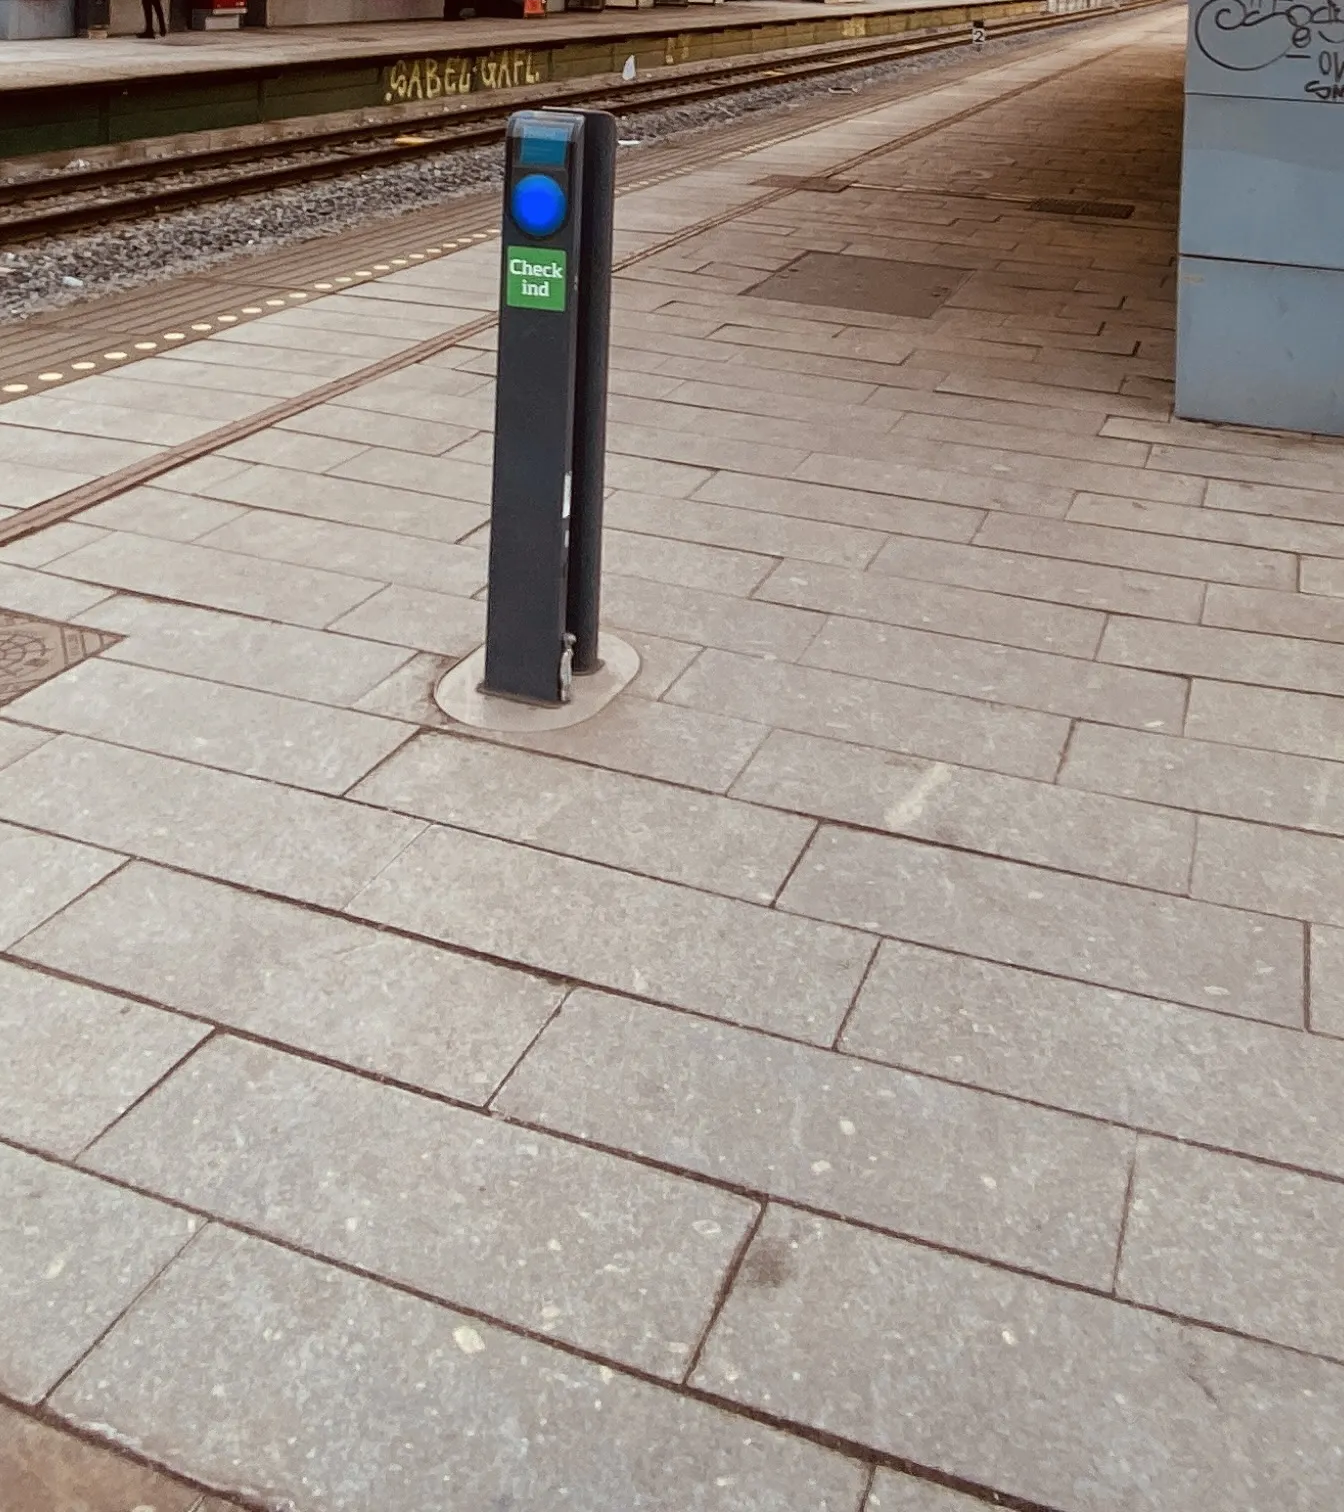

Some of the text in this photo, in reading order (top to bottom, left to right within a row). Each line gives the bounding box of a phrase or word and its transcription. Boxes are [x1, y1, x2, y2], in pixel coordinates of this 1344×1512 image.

[974, 30, 984, 42] 2
[509, 259, 563, 279] Check
[522, 280, 550, 297] ind
